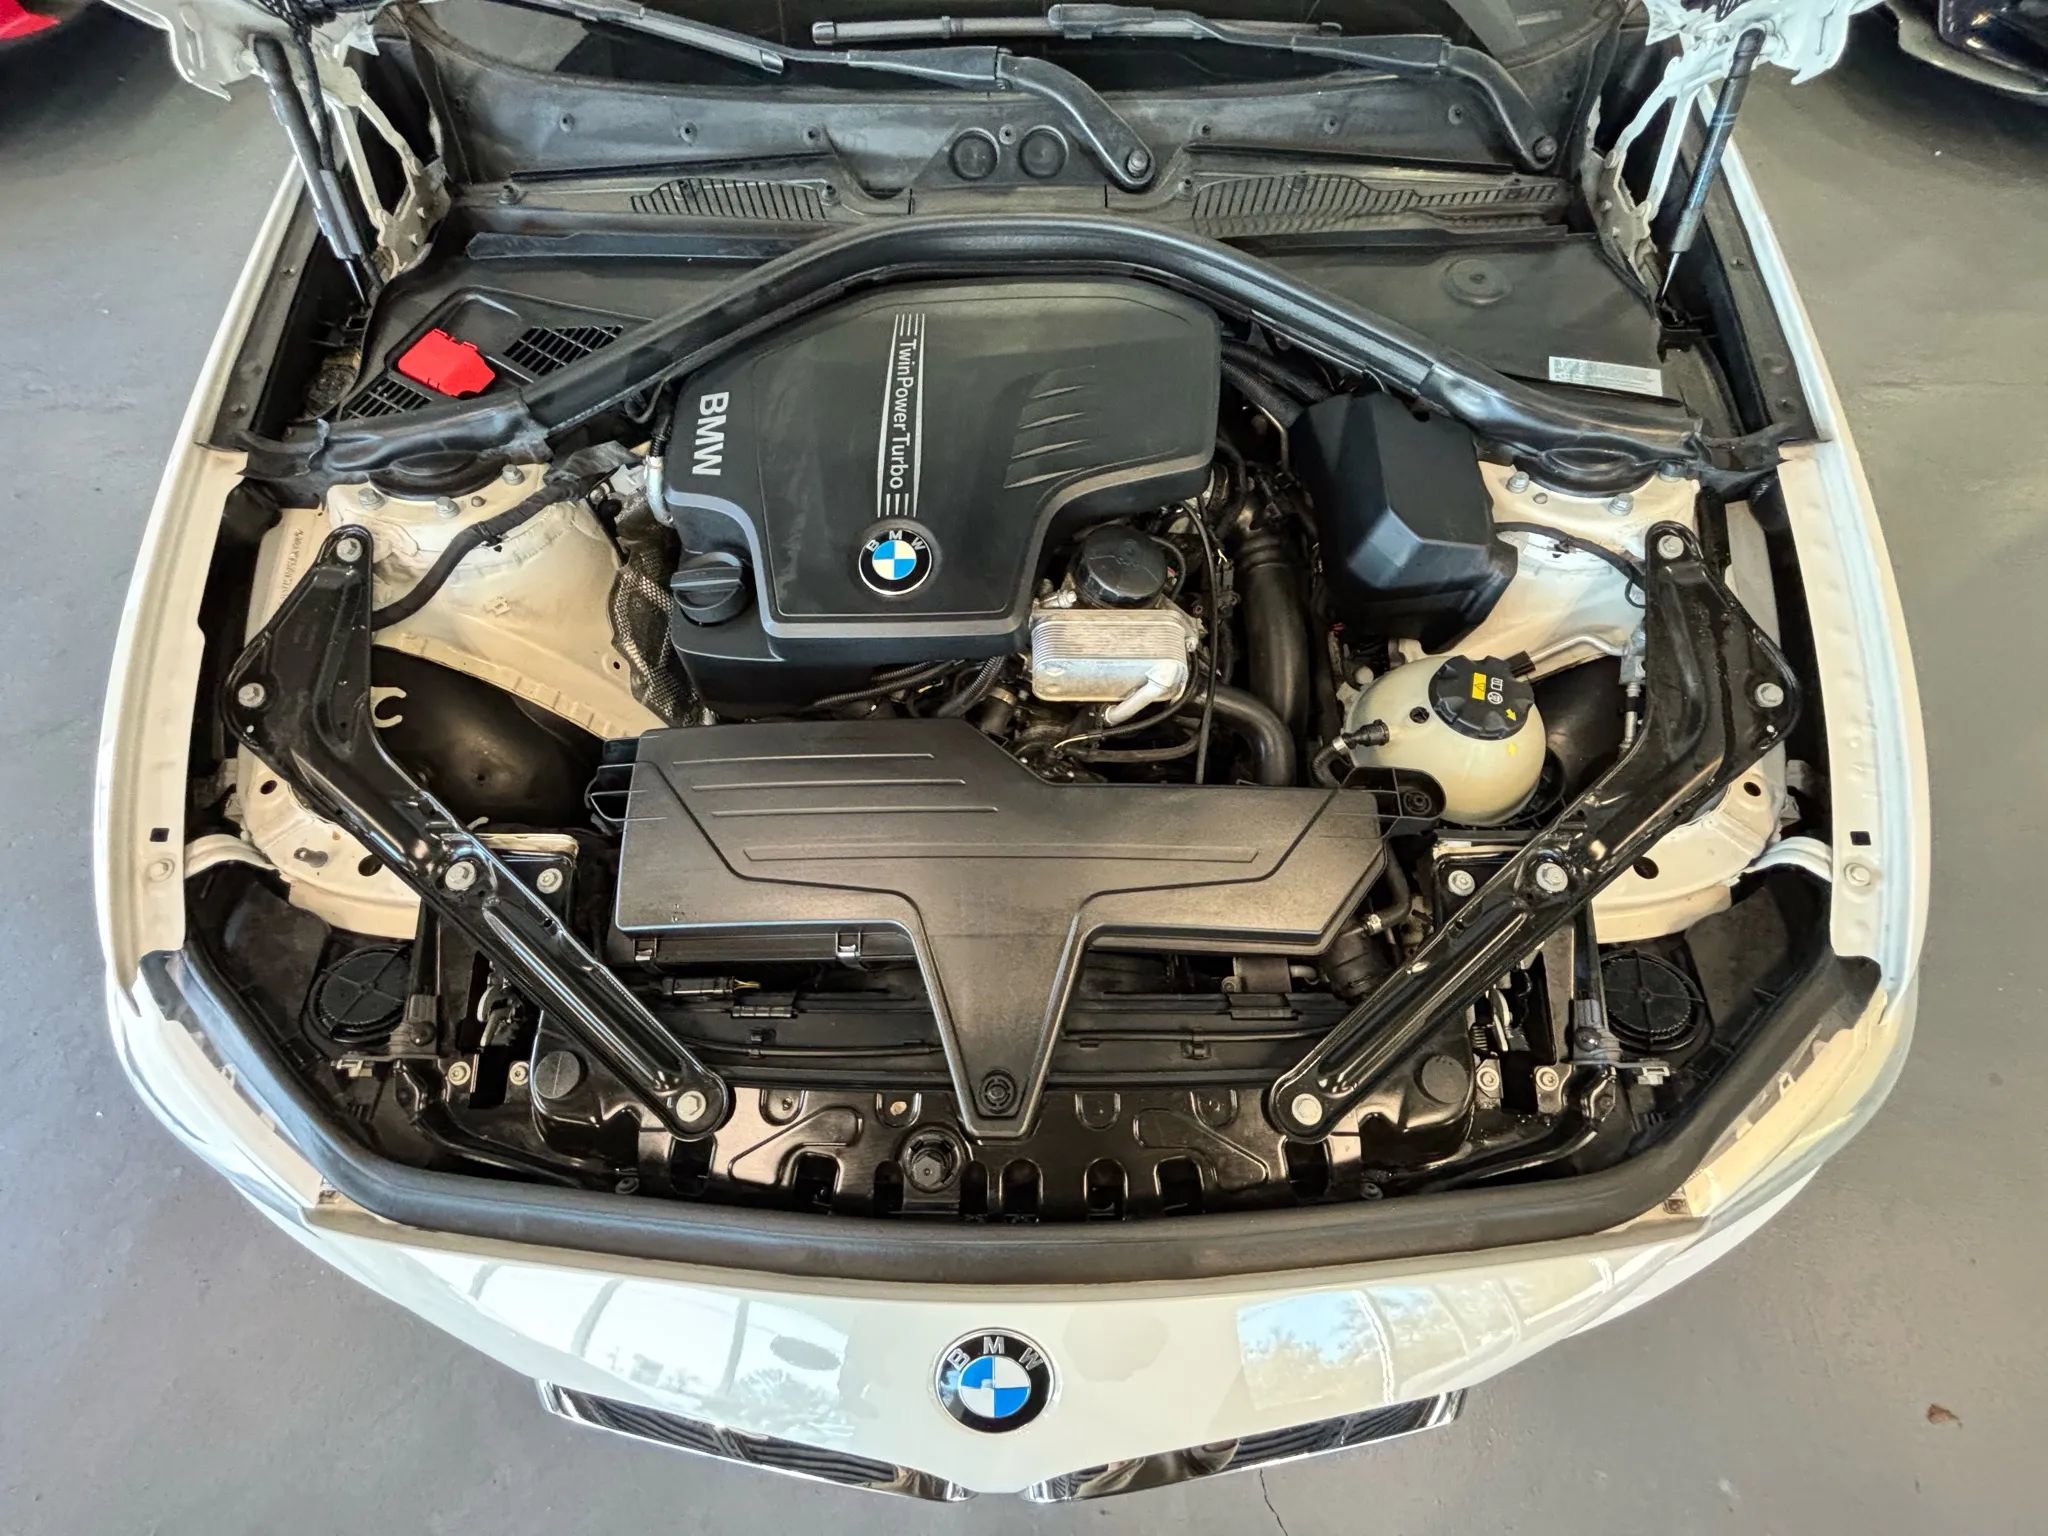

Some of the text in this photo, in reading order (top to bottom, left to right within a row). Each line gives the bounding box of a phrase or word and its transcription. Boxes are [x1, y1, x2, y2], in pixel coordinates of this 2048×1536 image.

[691, 391, 730, 476] BMW
[865, 529, 926, 552] BMW
[946, 1335, 1044, 1371] BMW
